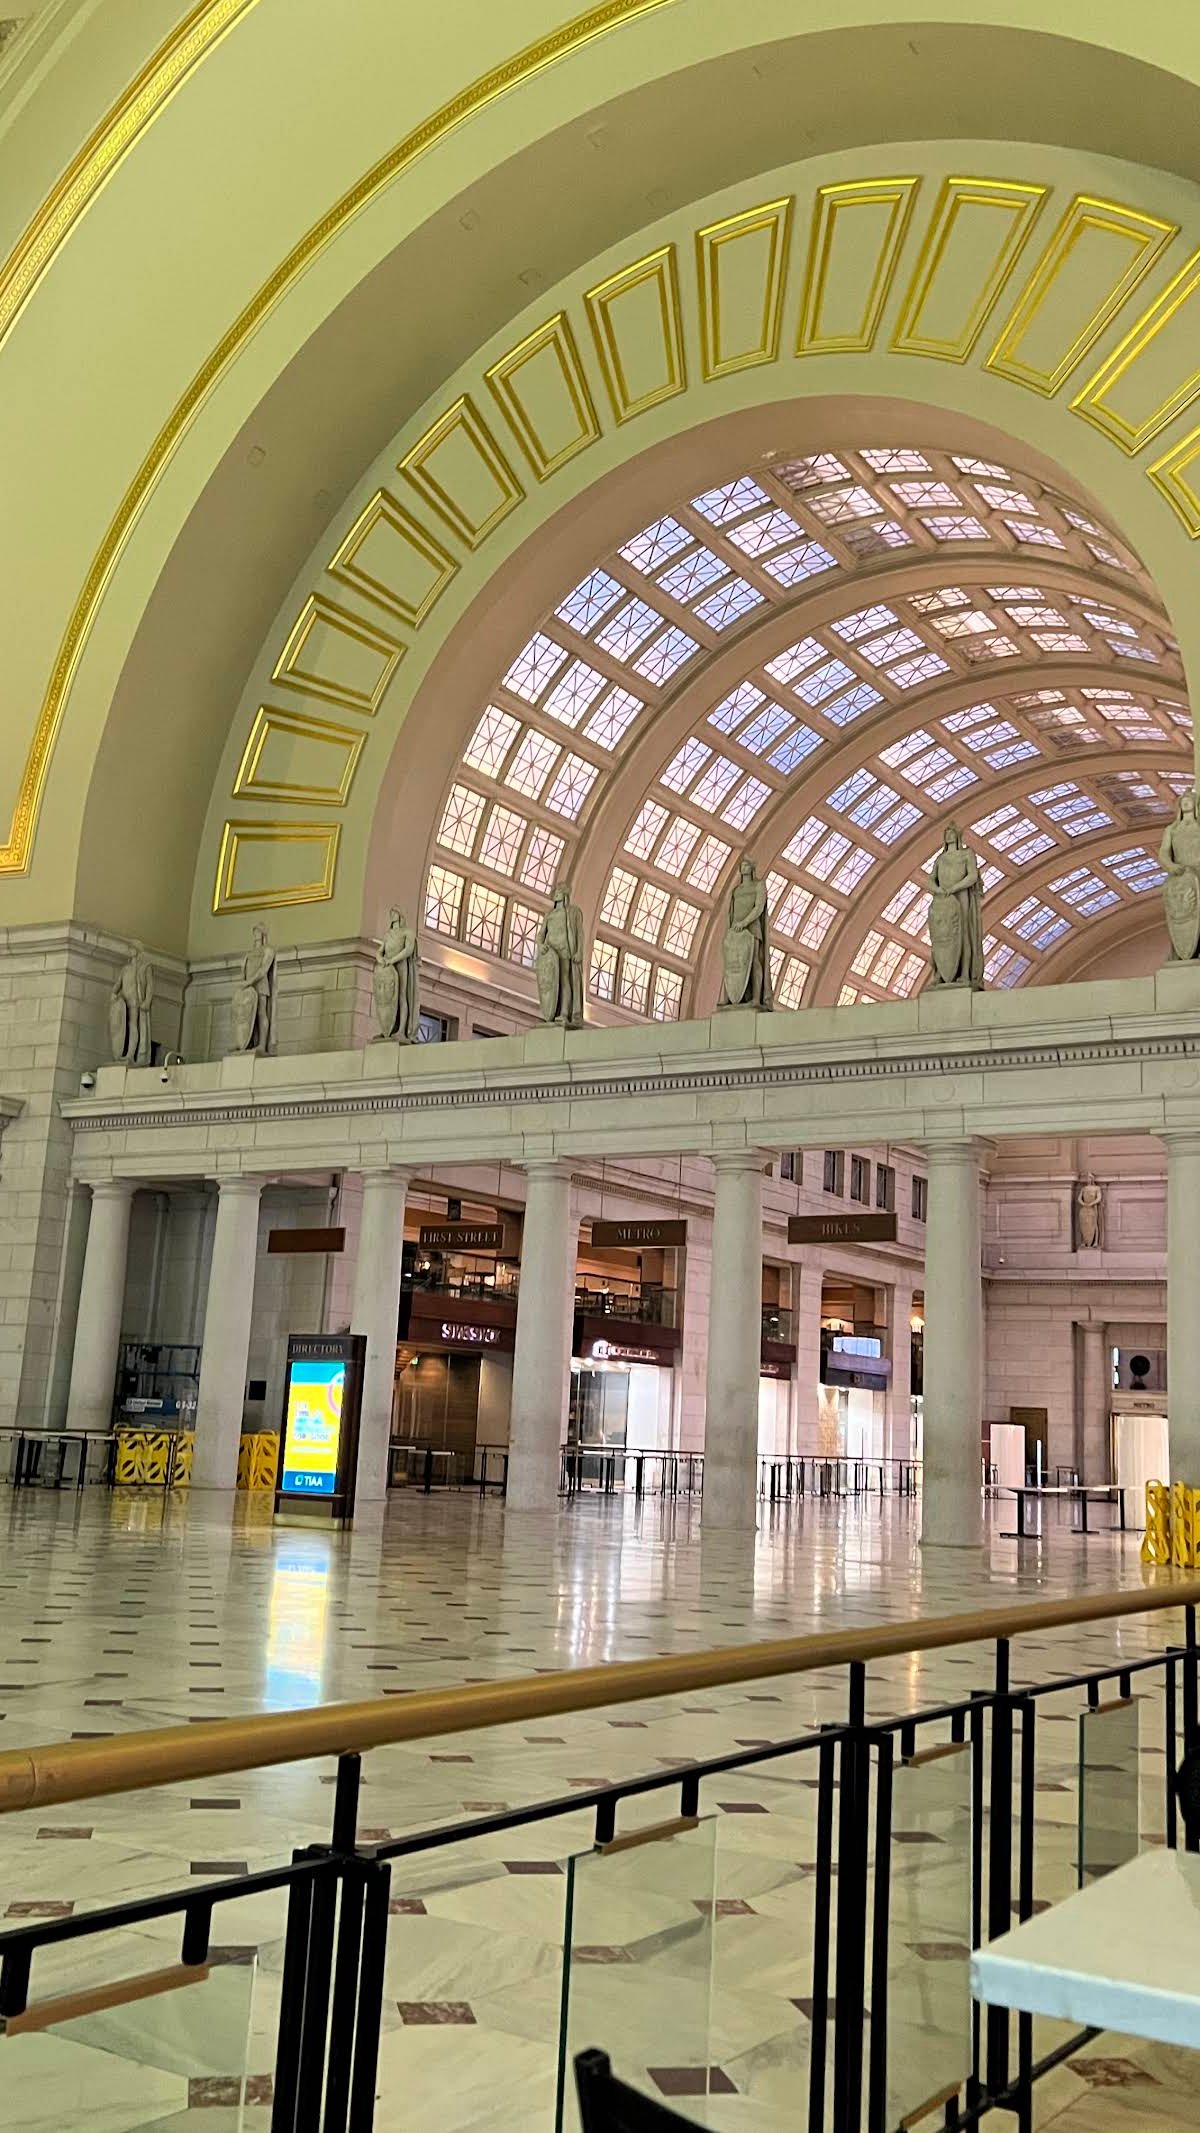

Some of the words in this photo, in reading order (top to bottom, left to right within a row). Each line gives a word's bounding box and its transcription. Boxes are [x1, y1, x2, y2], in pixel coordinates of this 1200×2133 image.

[616, 1227, 661, 1240] METRO
[822, 1223, 861, 1235] BIKES
[423, 1231, 453, 1243] FIRST
[456, 1231, 498, 1243] STREET
[291, 1343, 343, 1355] DIRECTORY
[304, 1475, 323, 1487] TIAA
